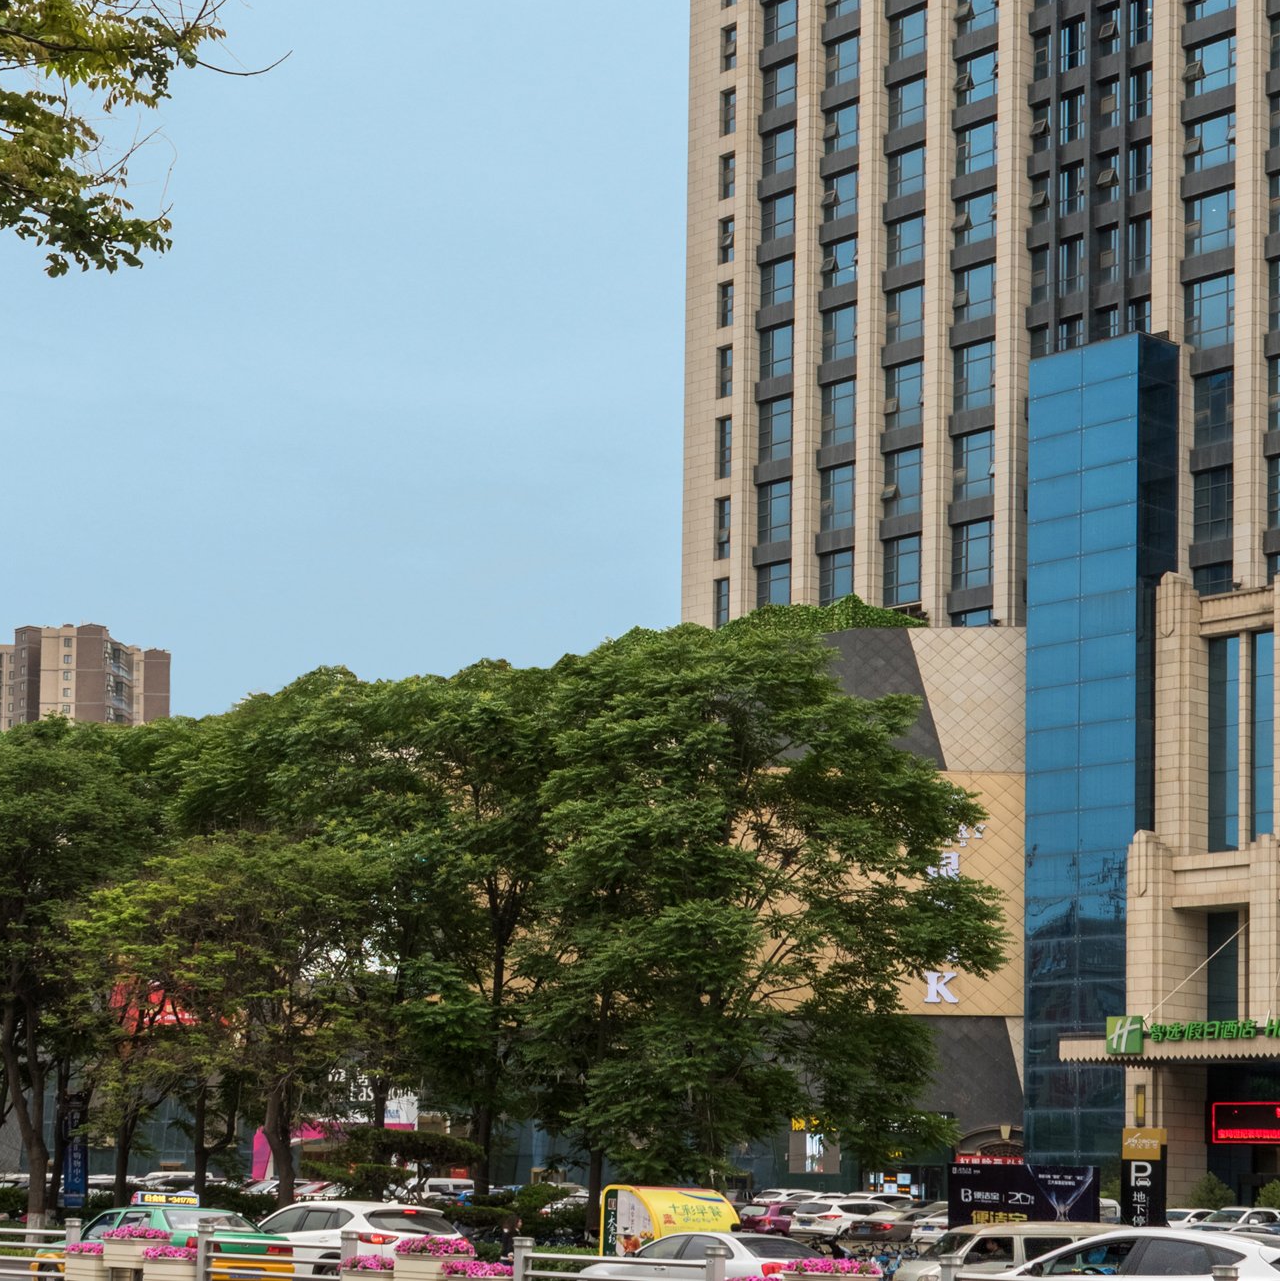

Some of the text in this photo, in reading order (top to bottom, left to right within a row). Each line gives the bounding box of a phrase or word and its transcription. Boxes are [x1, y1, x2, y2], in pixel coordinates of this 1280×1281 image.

[1149, 1020, 1258, 1043] 智选假日酒店
[1130, 1161, 1152, 1187] P
